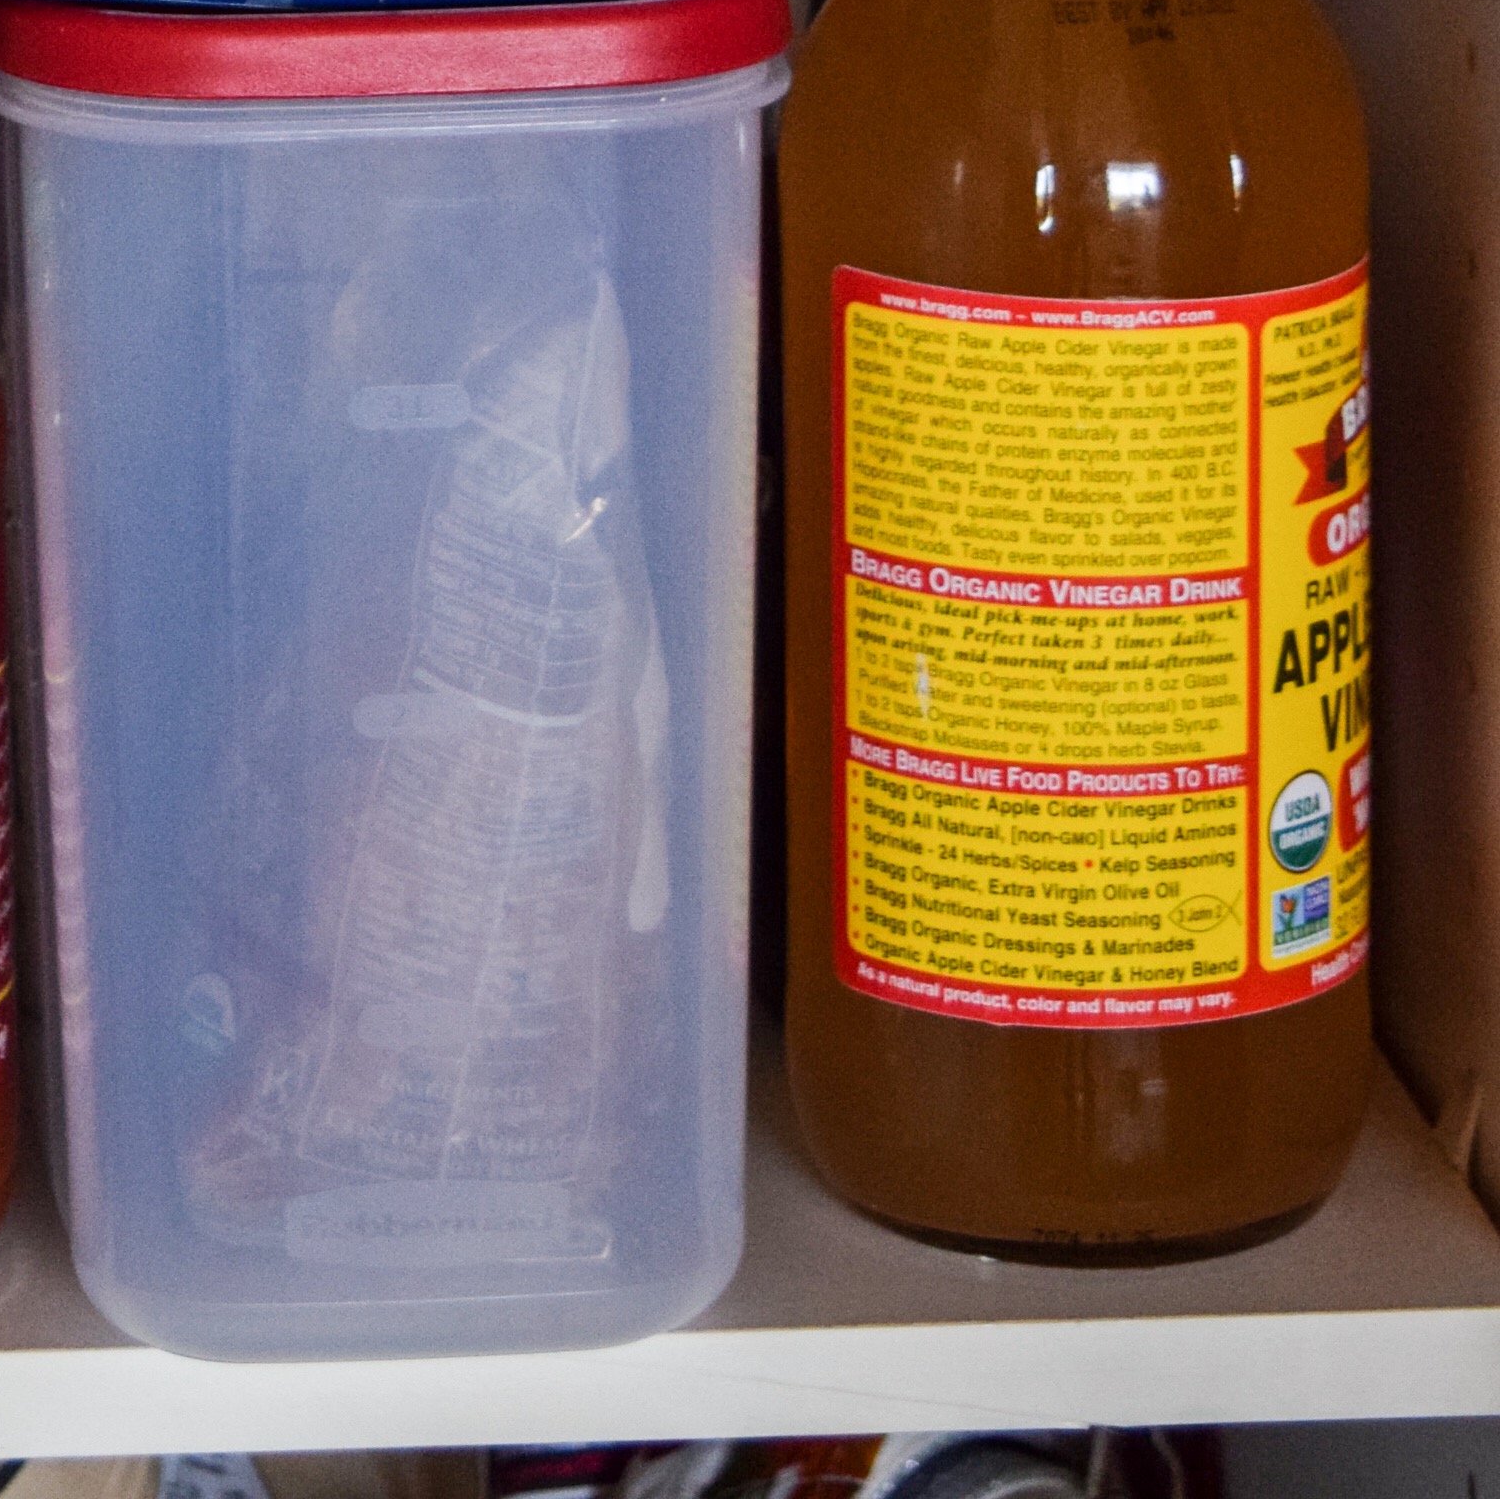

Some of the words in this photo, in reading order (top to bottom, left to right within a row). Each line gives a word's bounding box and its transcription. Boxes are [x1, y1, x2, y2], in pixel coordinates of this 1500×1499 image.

[880, 293, 1011, 321] www.bragg.com
[1031, 309, 1215, 329] www.BraggACV.com
[1305, 573, 1349, 609] RAW
[864, 771, 907, 801] Bragg
[912, 784, 980, 810] Organic
[987, 796, 1040, 817] Apple
[1047, 800, 1098, 818] Cider
[1105, 802, 1176, 821] Vinegar
[1182, 796, 1237, 814] Drinks
[1285, 791, 1321, 823] USDA
[864, 852, 907, 882] Bragg
[988, 879, 1035, 898] Extra
[1042, 882, 1096, 903] Virgin
[1103, 884, 1149, 900] Olive
[1156, 882, 1180, 898] Oil
